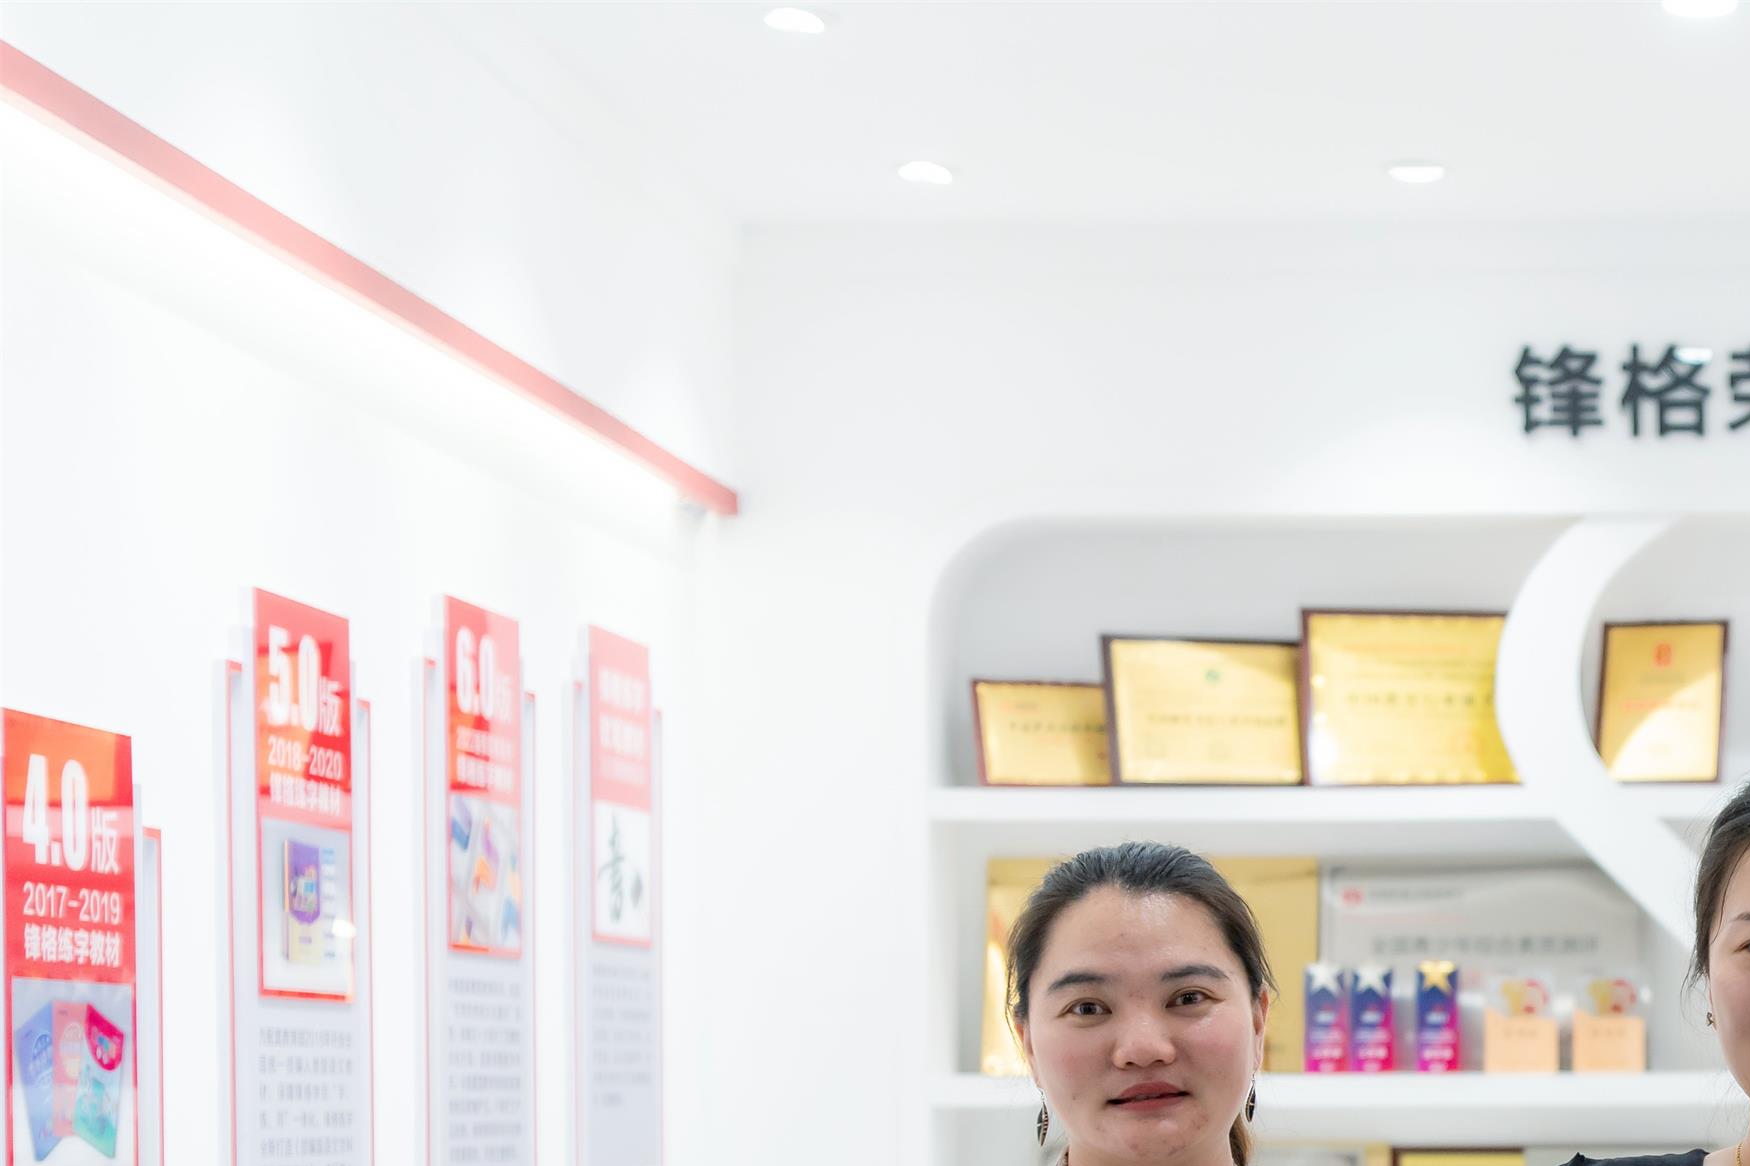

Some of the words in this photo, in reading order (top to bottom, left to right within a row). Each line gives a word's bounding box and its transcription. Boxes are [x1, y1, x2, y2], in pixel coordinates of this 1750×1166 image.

[267, 622, 341, 738] 5.0版
[266, 736, 342, 781] 2018-2020
[22, 752, 121, 876] 4.0版
[23, 880, 120, 925] 2017-2019
[24, 921, 121, 969] 锋格练字教材
